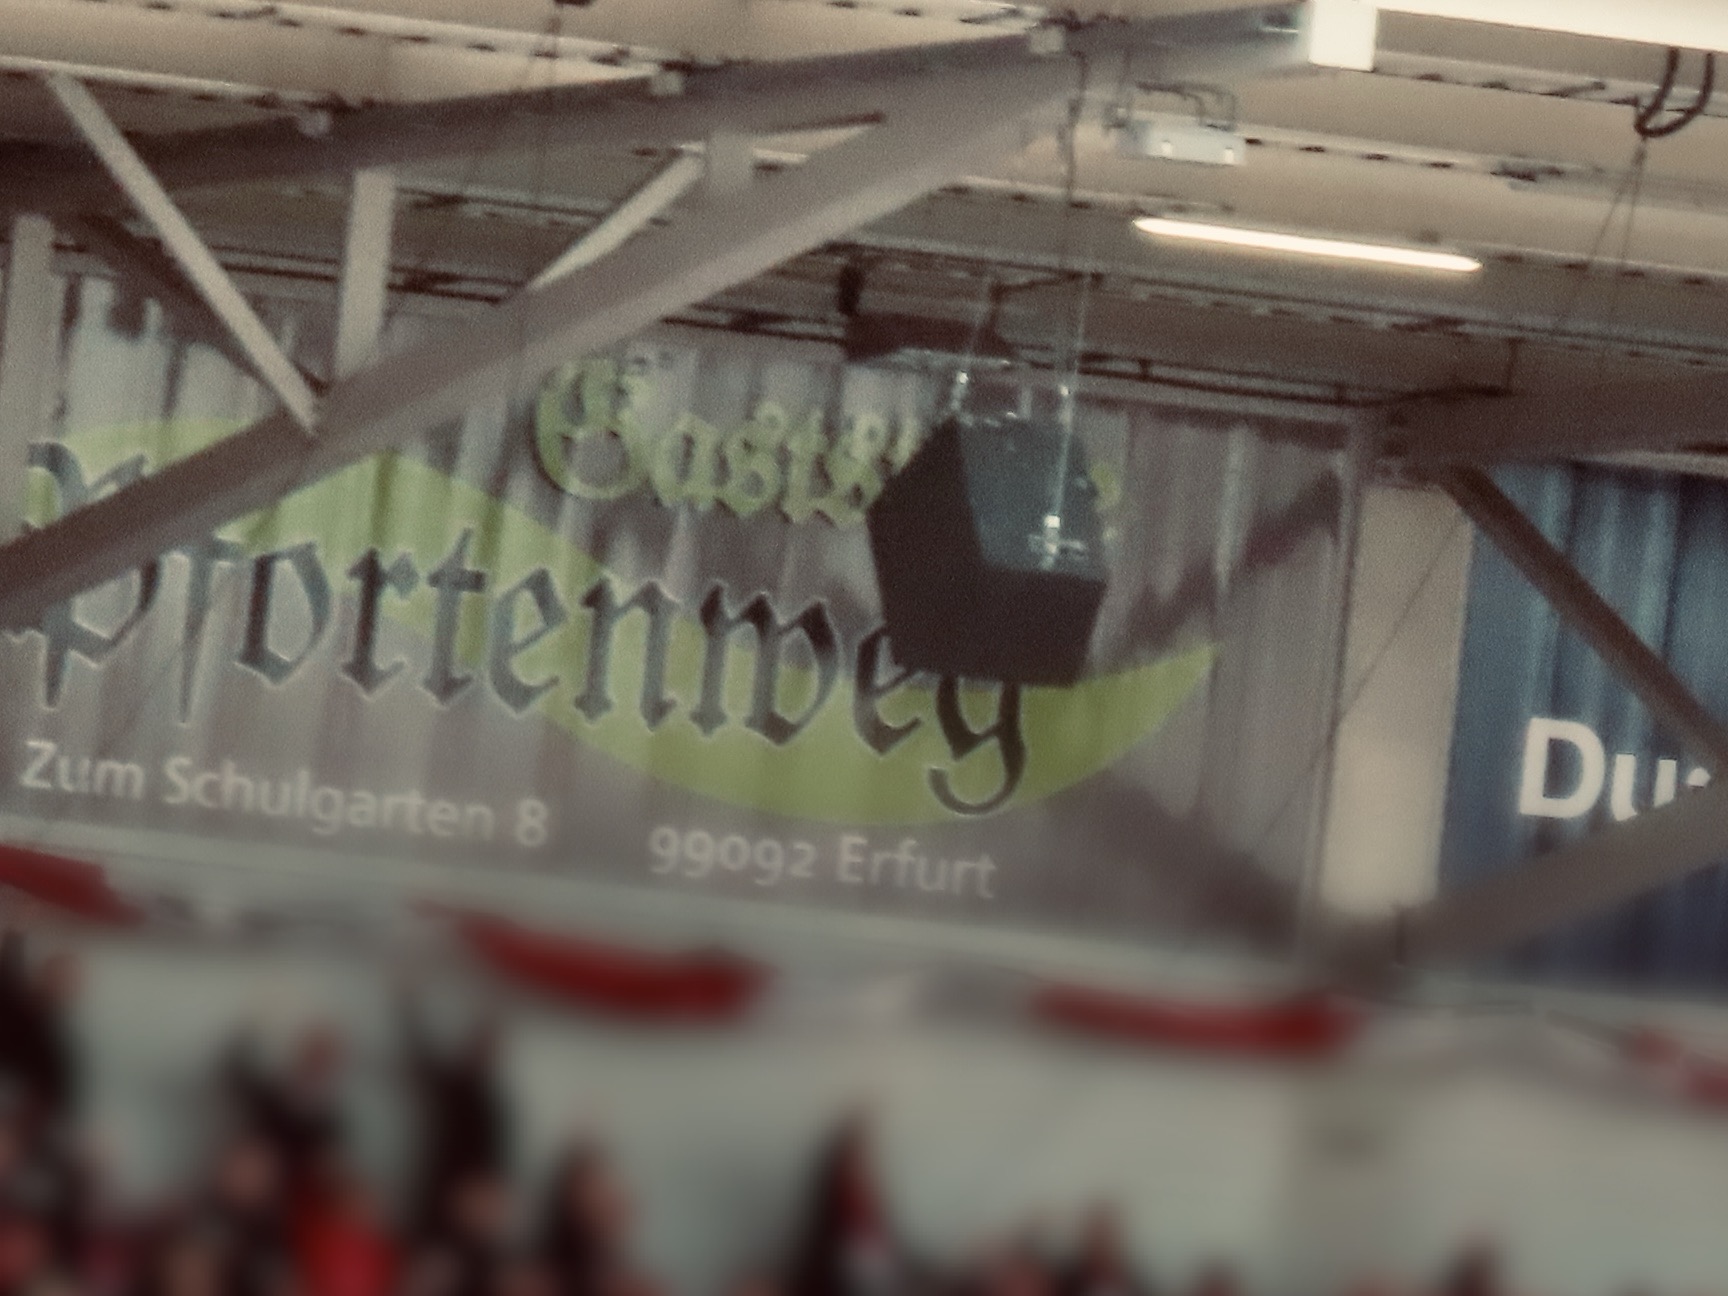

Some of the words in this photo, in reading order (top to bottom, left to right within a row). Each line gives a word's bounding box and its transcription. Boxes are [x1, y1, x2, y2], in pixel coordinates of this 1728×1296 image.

[19, 739, 144, 798] Zum
[162, 755, 493, 838] Schulgarten
[516, 799, 549, 847] 8
[649, 827, 819, 888] 99092
[837, 837, 996, 899] Erfurt
